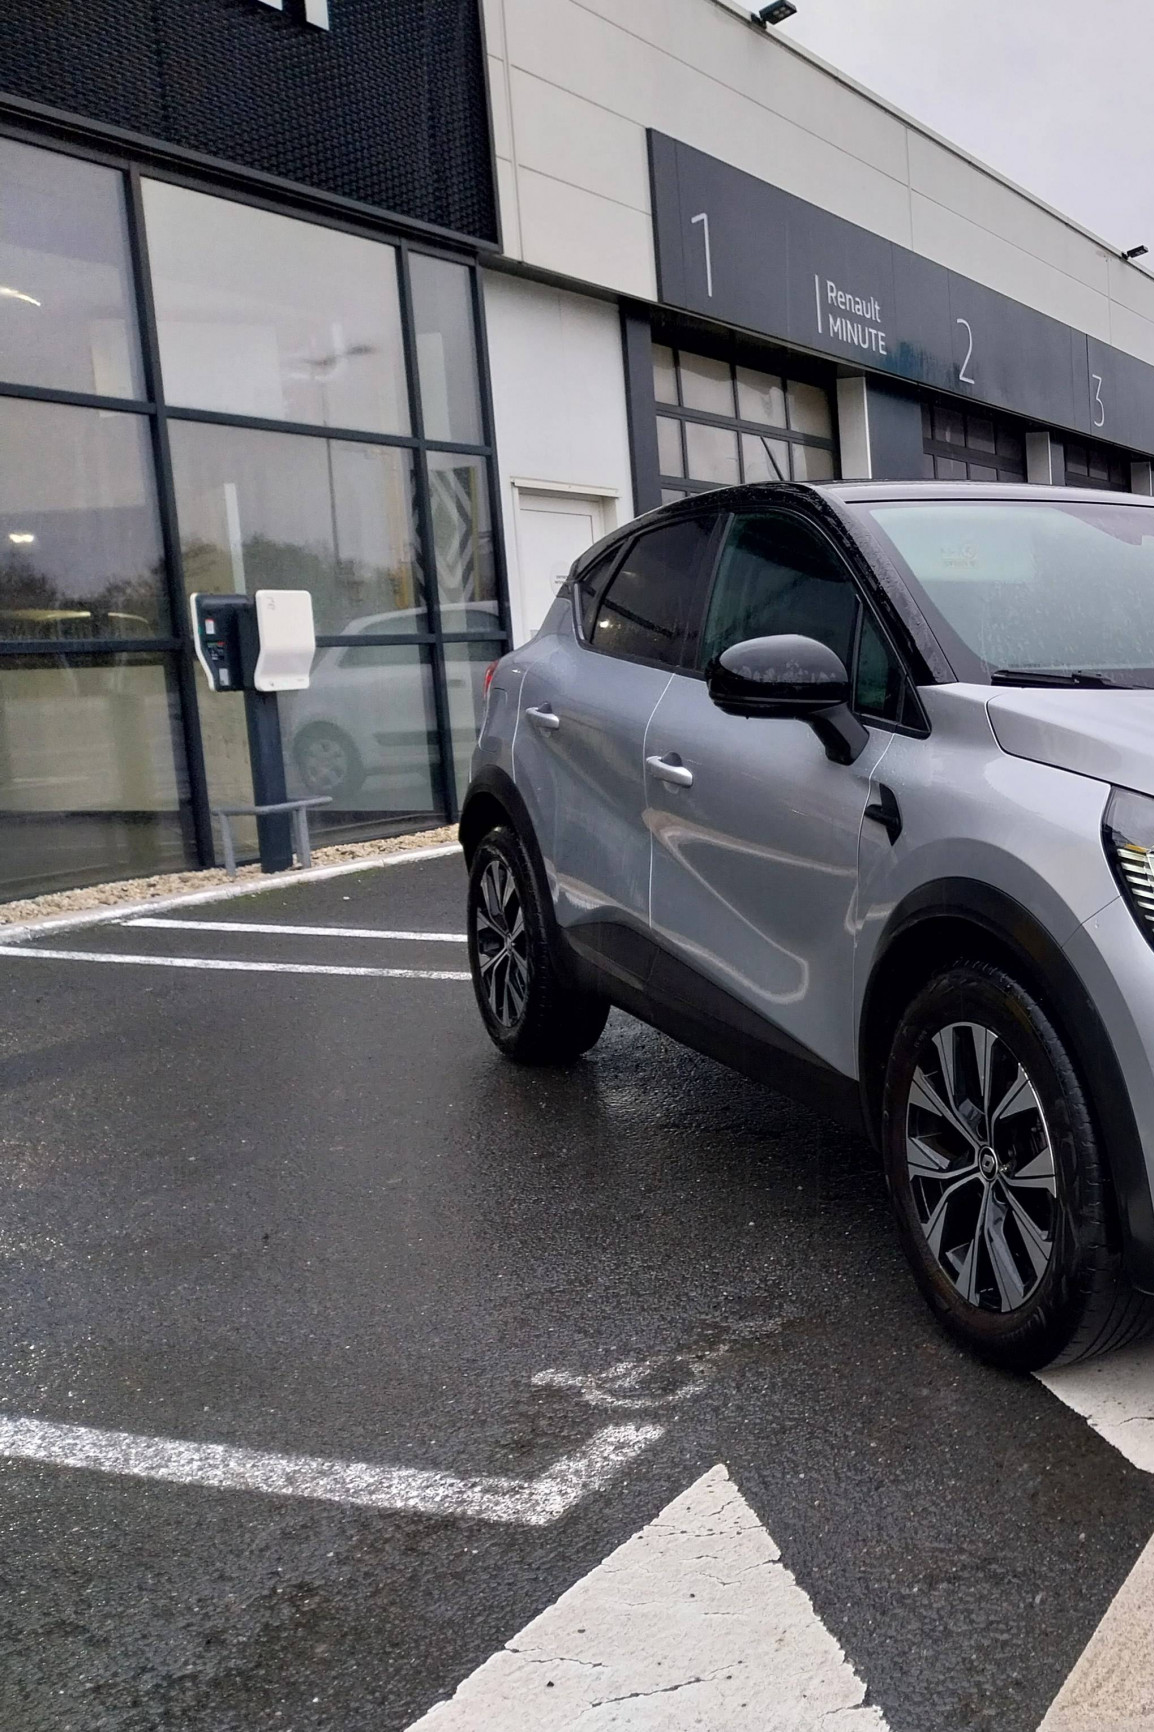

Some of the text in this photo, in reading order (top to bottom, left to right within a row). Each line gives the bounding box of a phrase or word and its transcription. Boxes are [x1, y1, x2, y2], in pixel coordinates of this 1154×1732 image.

[690, 212, 713, 298] 1
[826, 279, 882, 324] Renault
[827, 312, 888, 356] MINUTE
[956, 317, 975, 385] 2
[1091, 373, 1105, 428] 3
